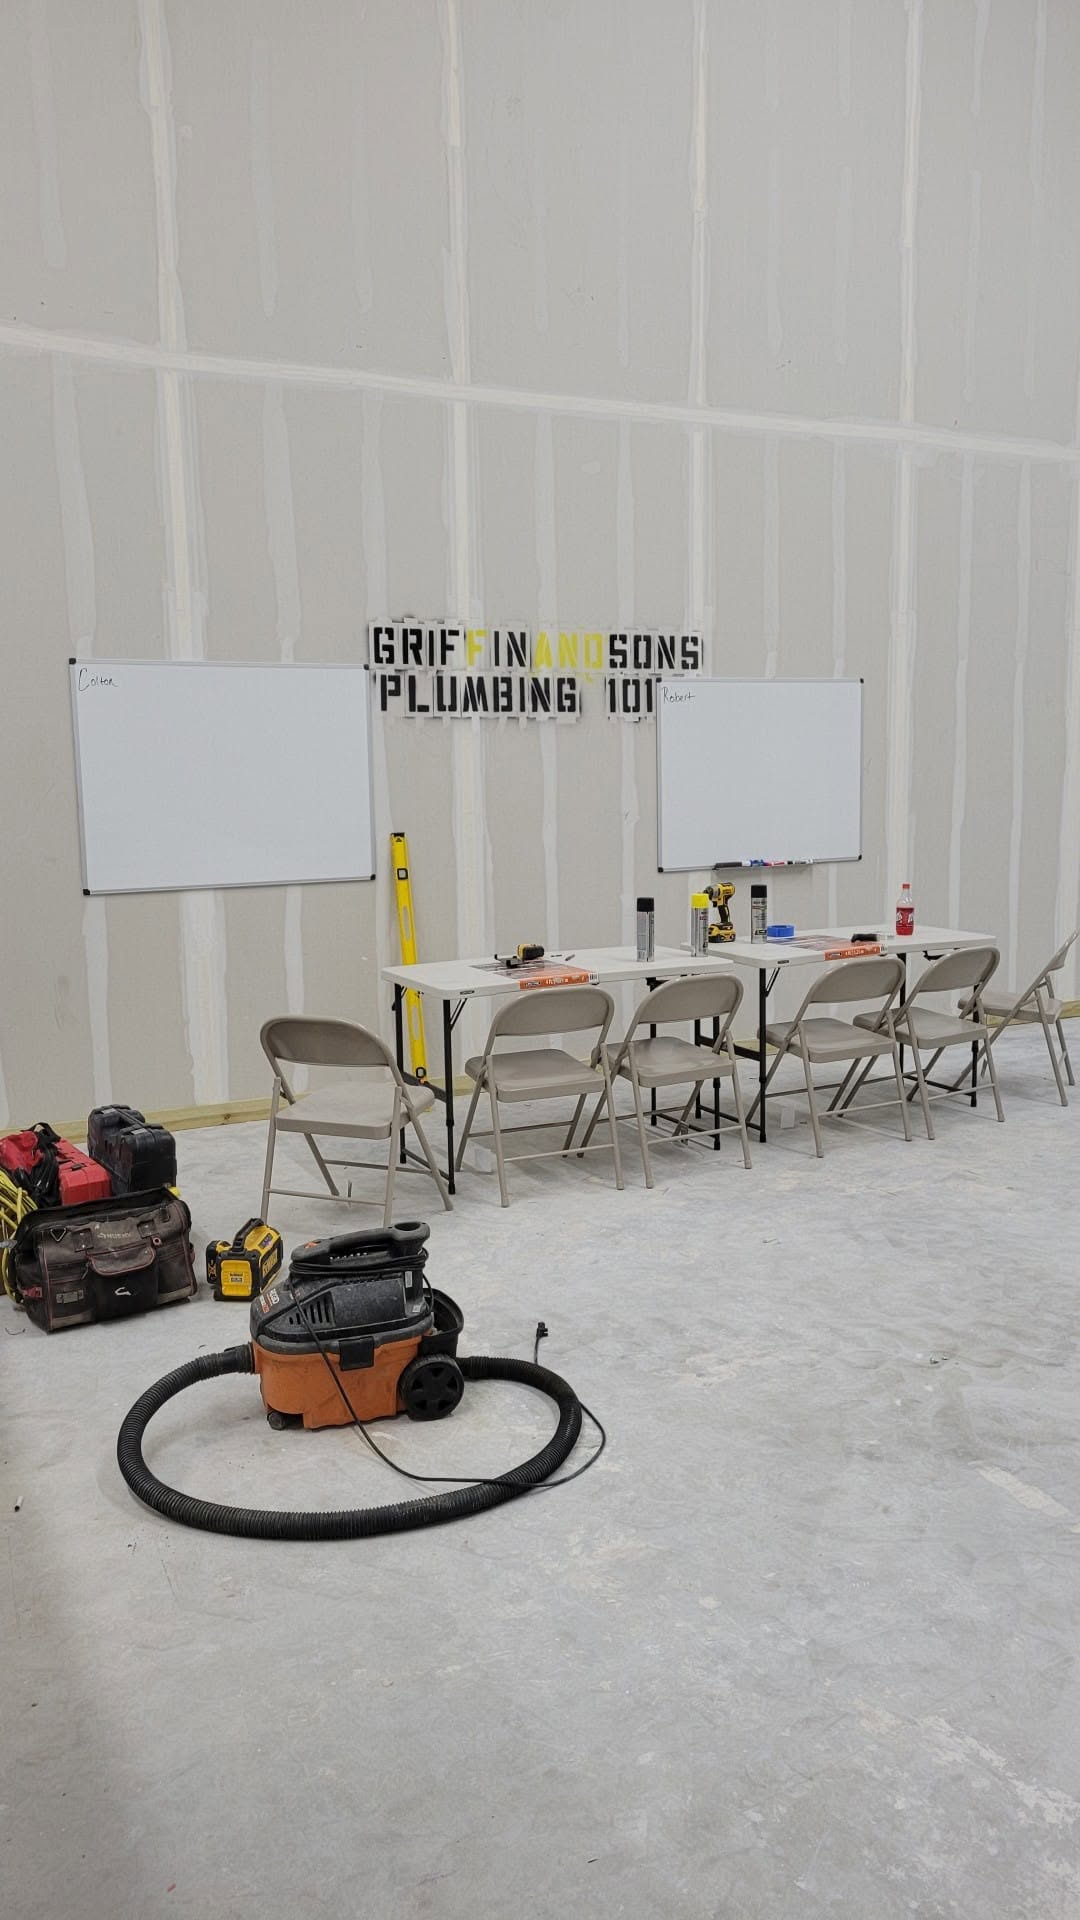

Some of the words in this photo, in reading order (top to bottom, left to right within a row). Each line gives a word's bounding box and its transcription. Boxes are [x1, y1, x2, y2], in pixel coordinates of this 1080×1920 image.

[373, 626, 527, 668] GRIFFIN
[534, 630, 604, 670] AND
[609, 633, 700, 670] SONS
[380, 674, 577, 713] PLUMBING
[607, 677, 653, 713] 101
[662, 686, 696, 704] Robert
